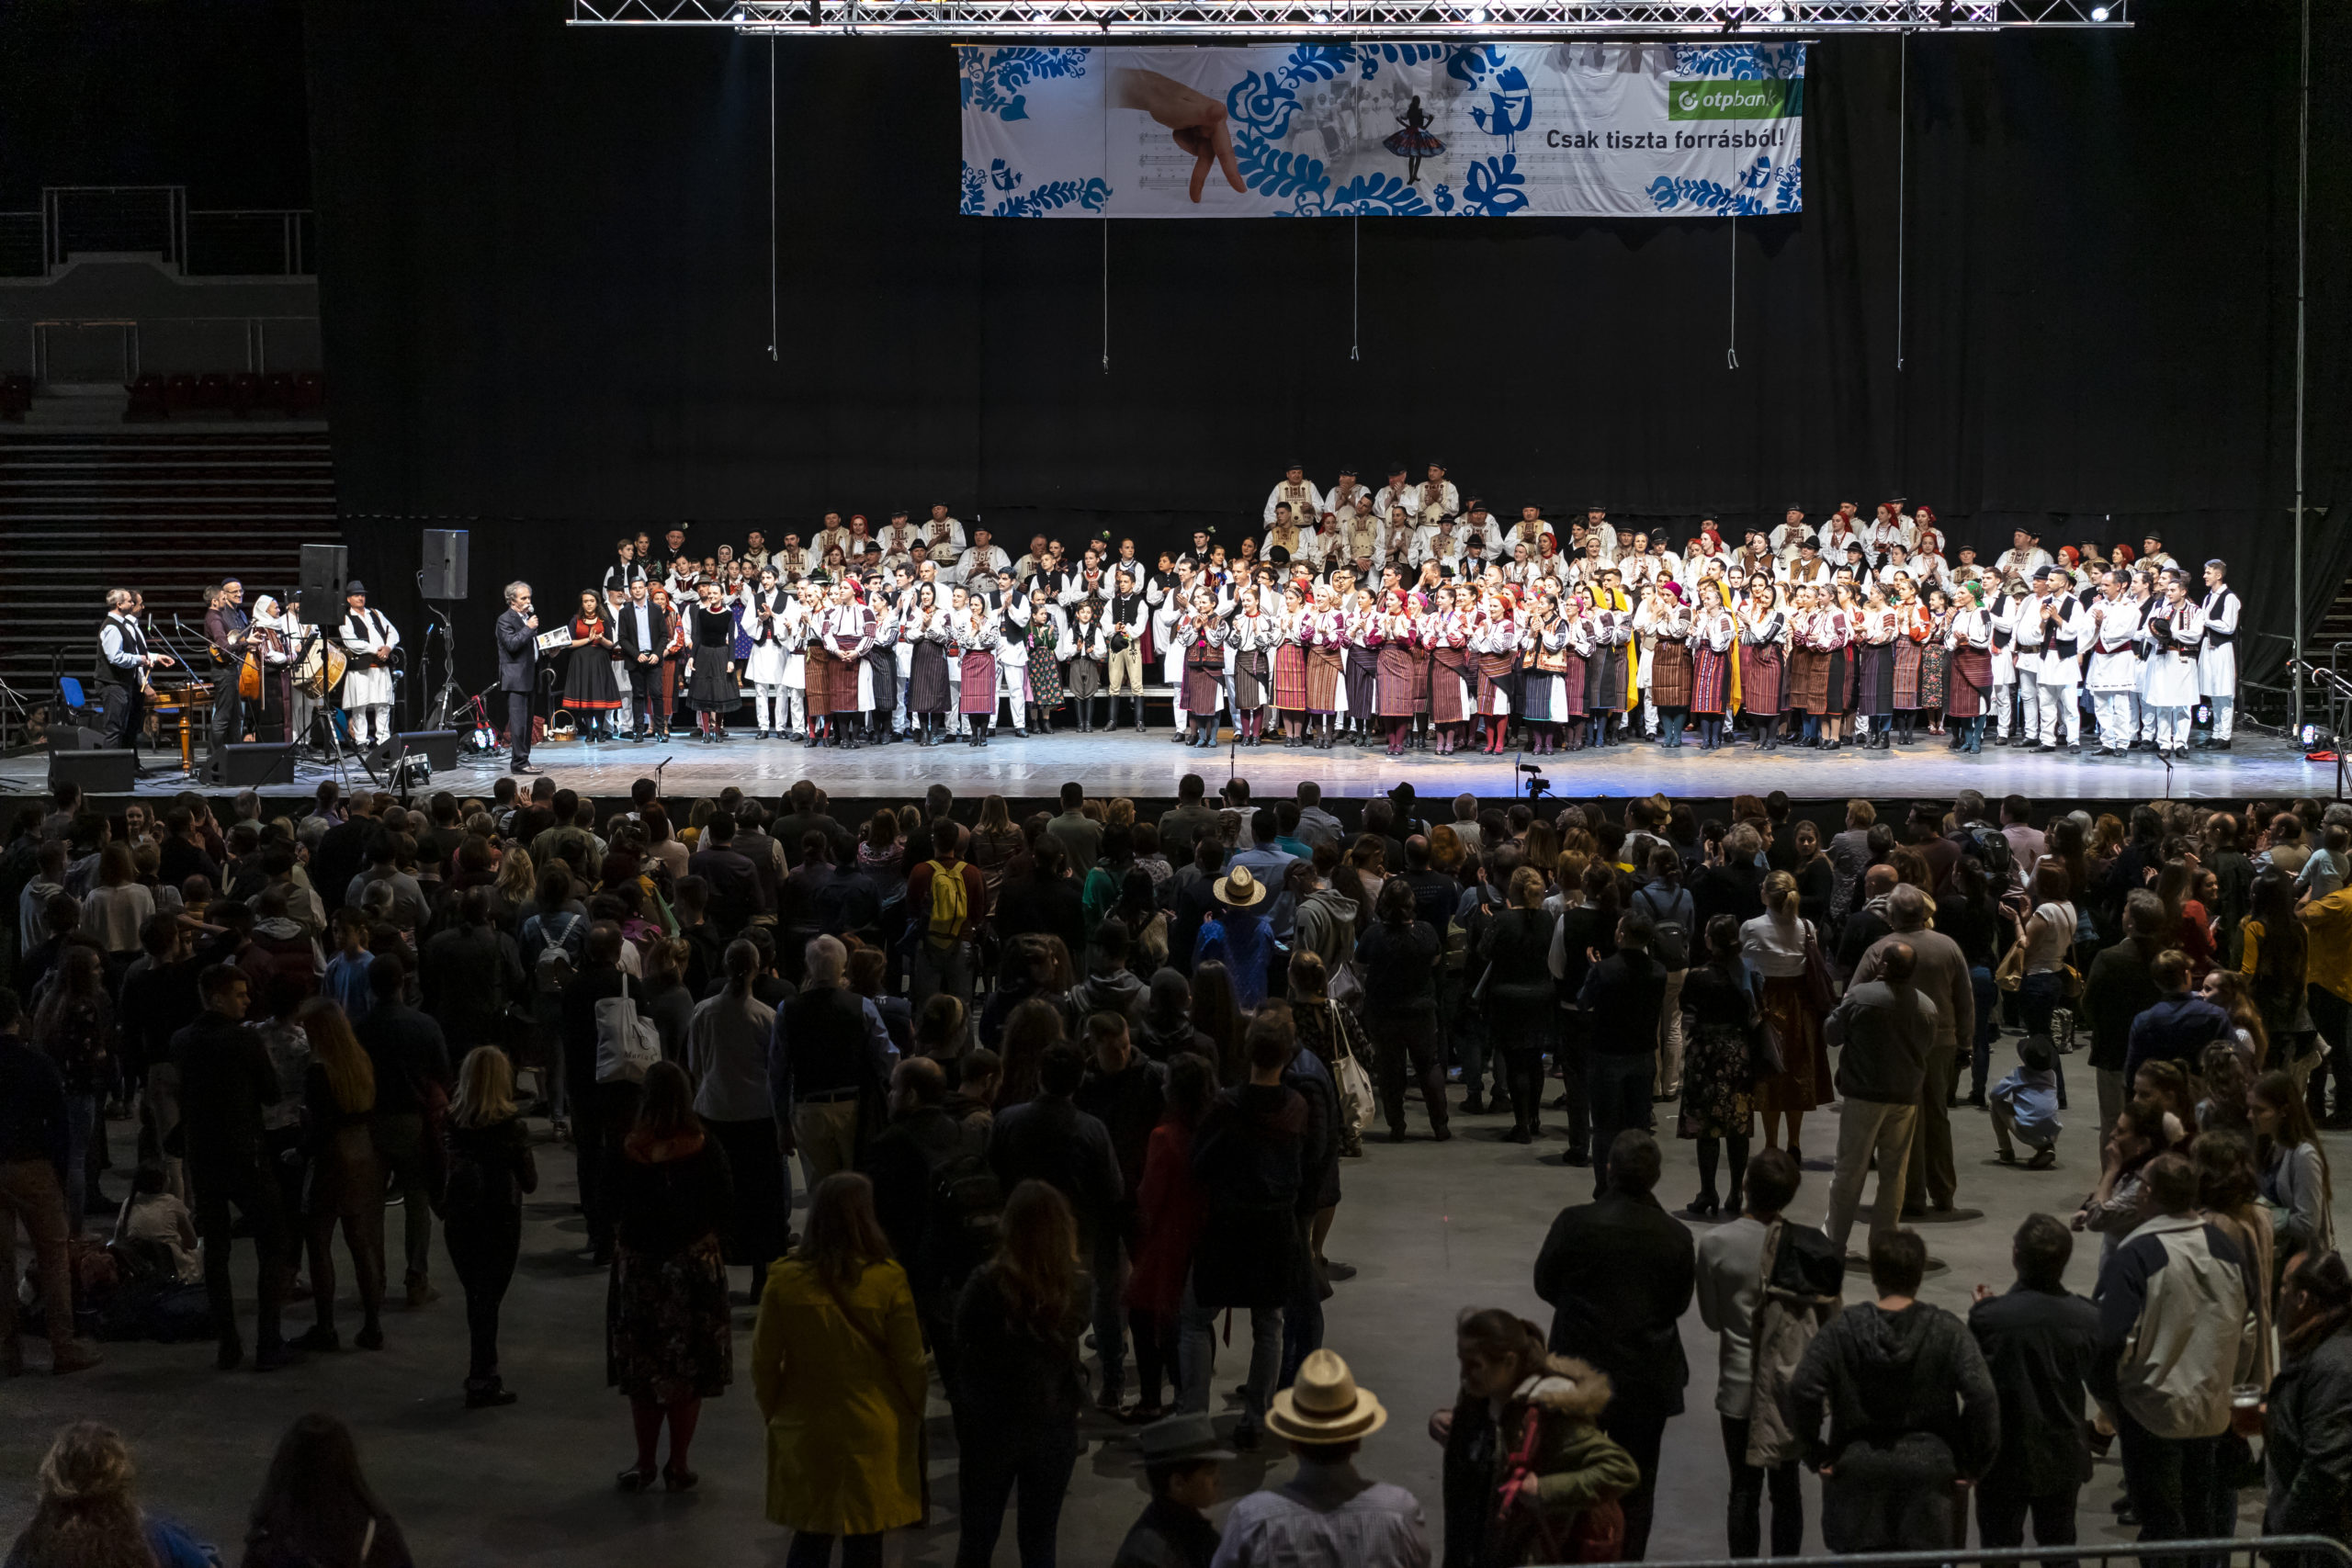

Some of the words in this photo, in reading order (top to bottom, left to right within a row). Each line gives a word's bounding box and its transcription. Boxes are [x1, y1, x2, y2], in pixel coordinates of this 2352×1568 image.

[1702, 90, 1777, 111] otpbank
[1546, 129, 1600, 149] Csak
[1606, 130, 1668, 149] tiszta
[1675, 129, 1784, 149] forrásból!
